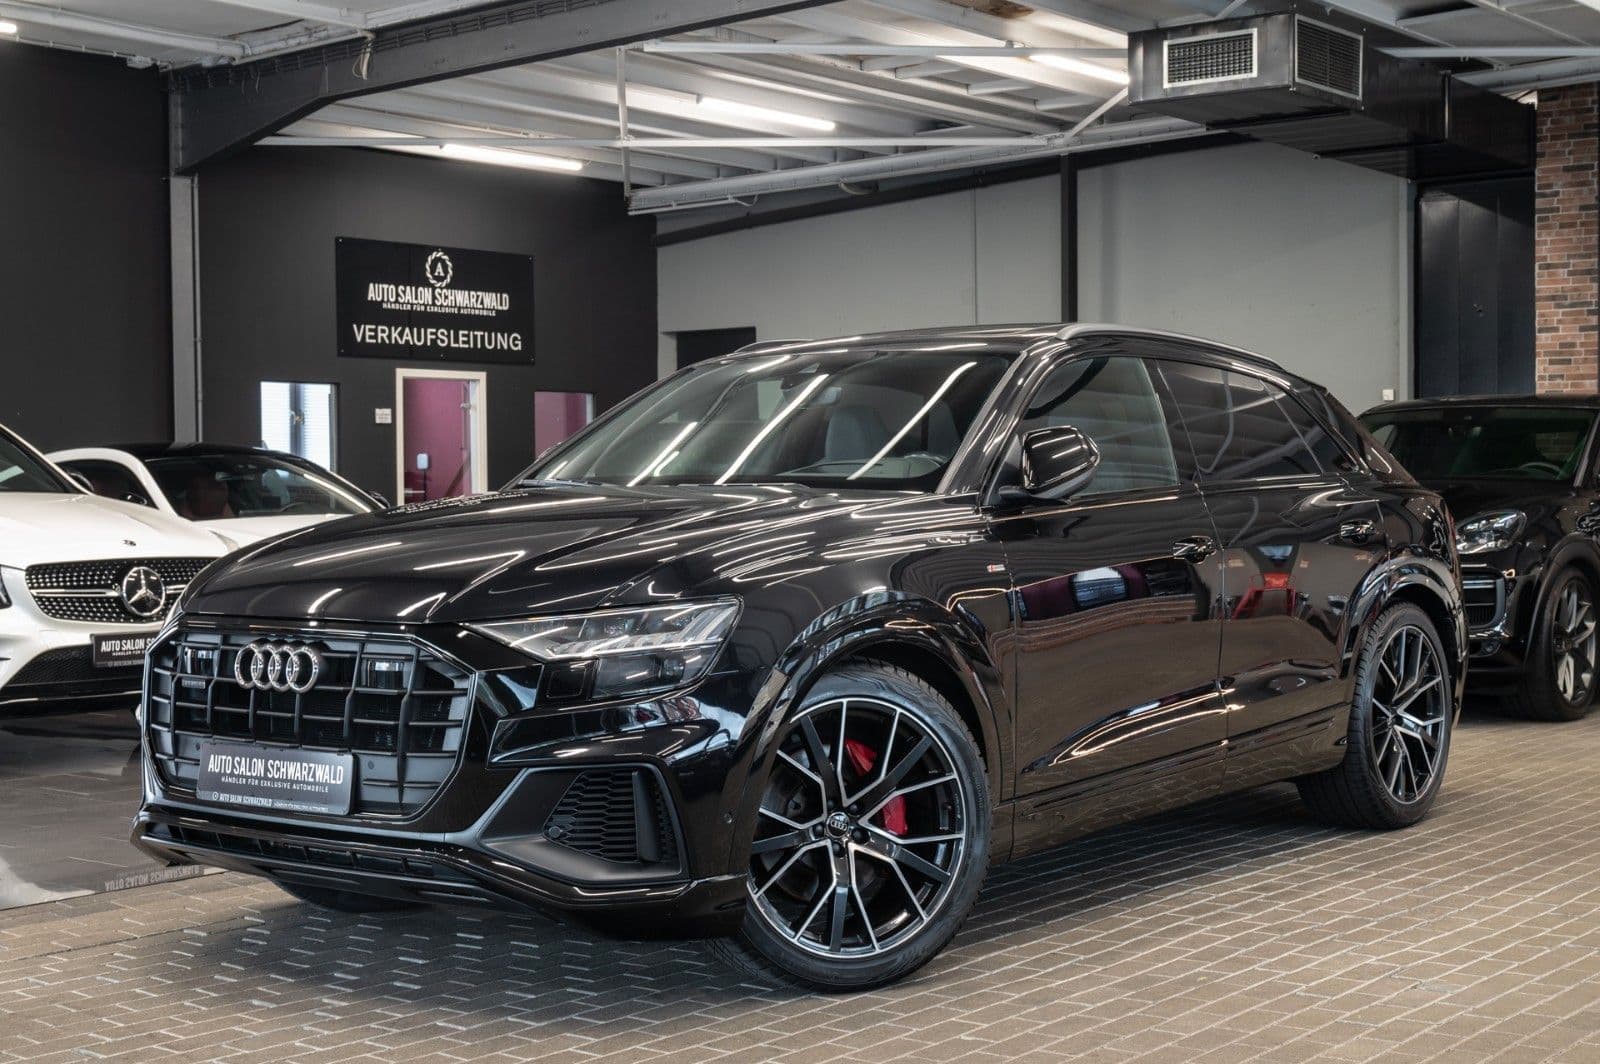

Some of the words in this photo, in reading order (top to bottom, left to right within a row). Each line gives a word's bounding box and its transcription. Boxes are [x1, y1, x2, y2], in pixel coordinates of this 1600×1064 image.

[434, 262, 445, 276] A
[367, 283, 398, 302] AUTO
[398, 285, 432, 305] SALON
[435, 288, 509, 311] SCHWARZWALD
[382, 302, 411, 311] HÄNDLER
[413, 303, 425, 312] FÜR
[460, 307, 496, 317] AUTOMOBILE
[352, 323, 522, 351] VERKAUFSLEITUNG
[101, 640, 121, 653] AUTO
[121, 638, 145, 650] SALON
[208, 754, 233, 774] AUTO
[233, 756, 264, 778] SALON
[267, 759, 344, 785] SCHWARZWALD
[221, 775, 246, 785] HÄNDLER
[248, 778, 259, 786] FÜR
[260, 780, 290, 790] EXKLUSIVE
[292, 783, 329, 793] AUTOMOBILE
